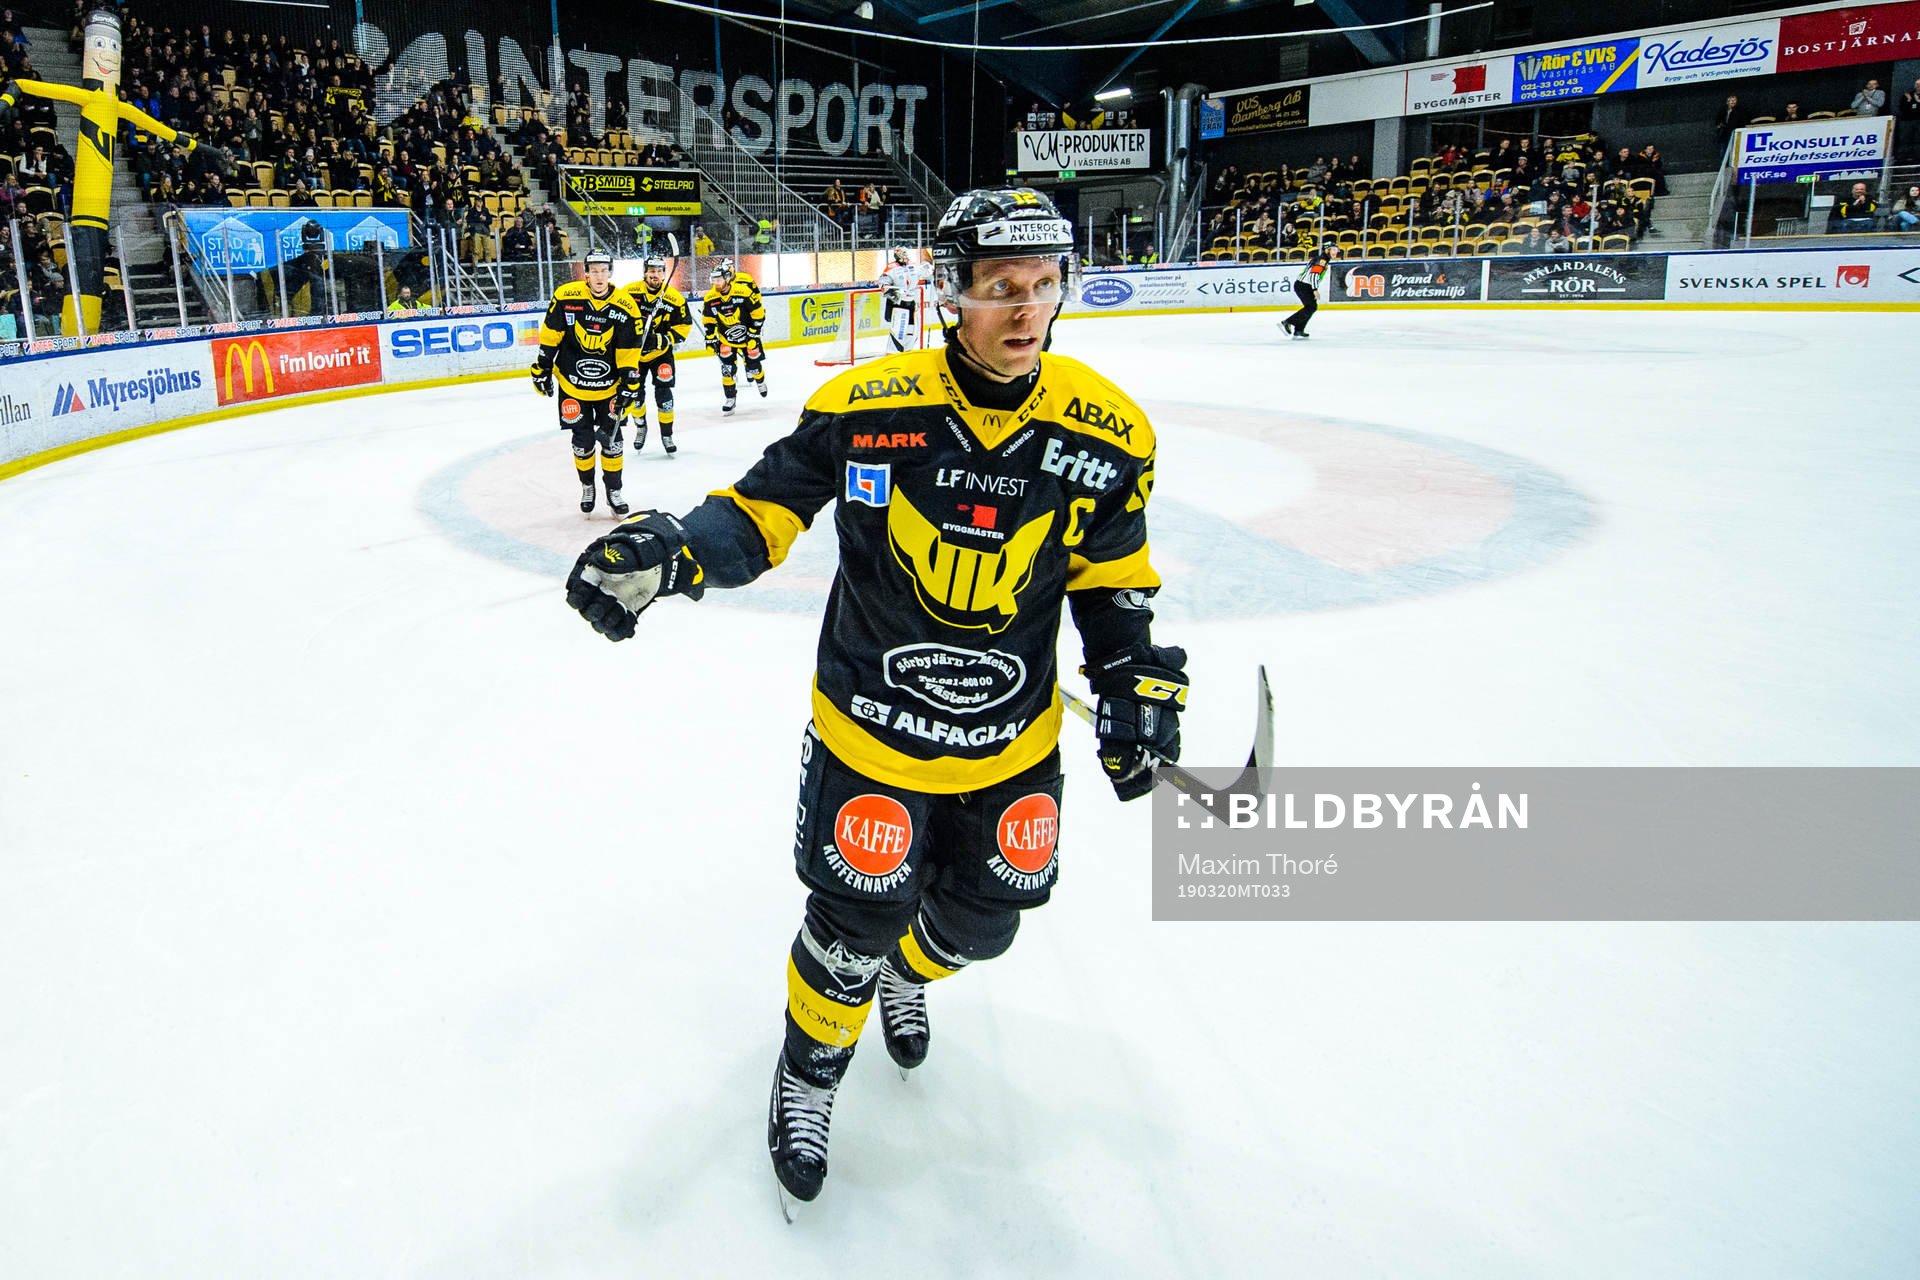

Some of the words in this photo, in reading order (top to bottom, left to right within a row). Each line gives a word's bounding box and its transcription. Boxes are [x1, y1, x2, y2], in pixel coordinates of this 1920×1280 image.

[1541, 54, 1570, 71] Rör
[1585, 46, 1616, 64] VVS
[1644, 36, 1773, 74] Kadesjös
[1541, 65, 1594, 79] Västerås
[1601, 62, 1616, 72] AB
[464, 29, 928, 158] INTERSPORT
[1521, 81, 1551, 91] 021-33
[1414, 92, 1501, 110] BYGGMÄSTER
[1768, 136, 1849, 152] KONSULT
[1851, 134, 1878, 146] AB
[1078, 157, 1119, 167] VÄSTERÅS
[1744, 147, 1877, 165] Fastighetsservice
[598, 175, 633, 188] SMIDE
[653, 180, 695, 190] STEELPRO
[1009, 223, 1059, 233] INTEROC
[208, 237, 243, 250] STAD
[1009, 233, 1060, 243] AKUSTIK
[1391, 273, 1432, 286] Brand
[1523, 261, 1626, 285] MÄLARDALENS
[1353, 274, 1385, 297] PG
[1391, 285, 1466, 298] Arbetsmiljö
[1549, 276, 1597, 293] RÖR
[1679, 277, 1769, 289] SVENSKA
[1776, 276, 1827, 289] SPEL
[274, 316, 323, 328] INTERSPORT
[336, 311, 382, 322] INTERSPORT
[153, 327, 200, 340] INTERSPORT
[214, 320, 262, 333] INTERSPORT
[802, 323, 840, 336] Järnarb
[91, 331, 139, 346] INTERSPORT
[391, 322, 514, 358] SECO
[309, 348, 355, 370] lovin'
[356, 345, 371, 365] it
[88, 368, 201, 411] Myresjöhus
[848, 374, 925, 405] ABAX
[939, 372, 968, 411] CCM
[1017, 386, 1047, 423] CCM
[1062, 397, 1135, 446] ABAX
[852, 432, 929, 448] MARK
[965, 472, 1029, 497] INVEST
[1062, 497, 1096, 546] C
[942, 522, 1005, 540] BYGGMÄSTER
[896, 654, 931, 673] Sörby
[932, 653, 964, 667] Järn
[978, 655, 1016, 680] Metall
[841, 815, 905, 854] KAFFE
[1005, 816, 1055, 850] KAFFE
[823, 844, 913, 893] KAFFEKNAPPEN
[824, 988, 862, 1004] CCM
